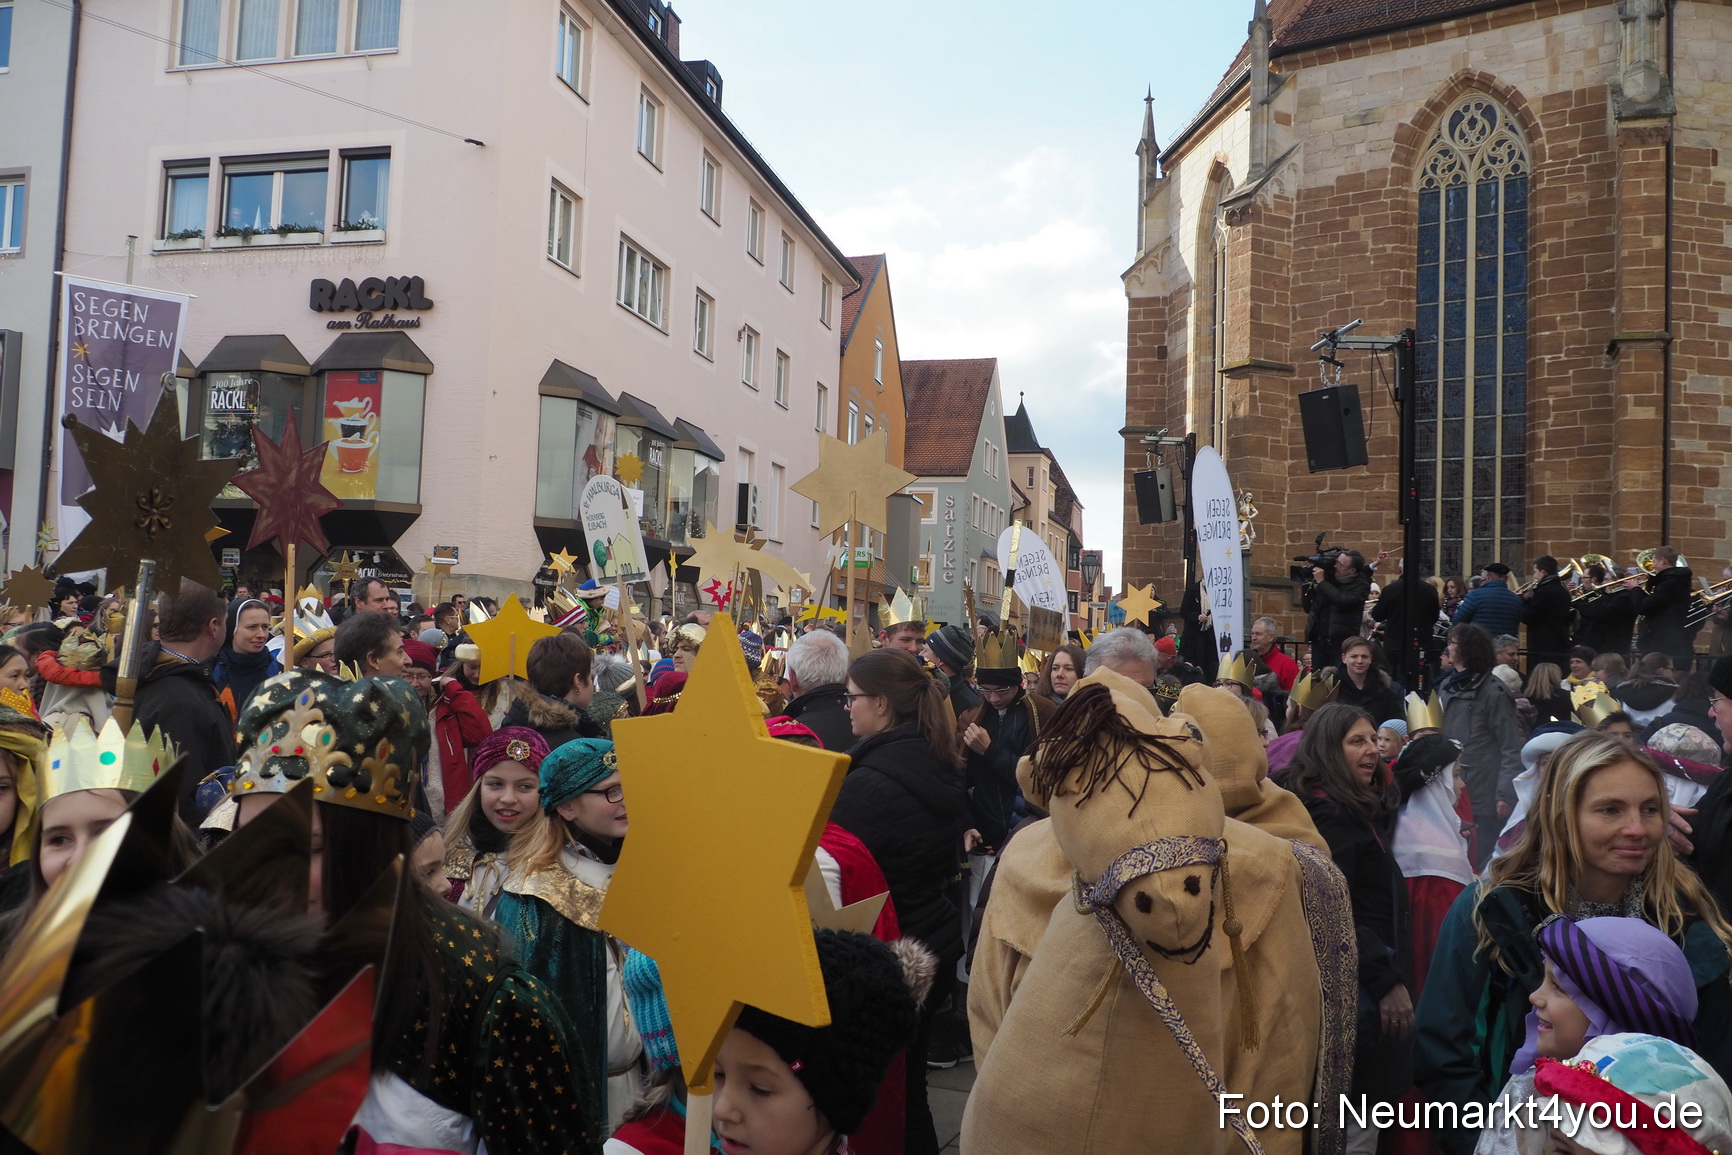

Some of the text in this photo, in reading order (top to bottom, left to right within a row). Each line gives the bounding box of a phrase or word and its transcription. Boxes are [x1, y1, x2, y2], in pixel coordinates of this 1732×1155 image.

[74, 292, 149, 323] SEGEN
[310, 275, 434, 312] RACKL
[74, 316, 173, 348] BRINGEN
[326, 311, 421, 329] am Rathaus
[72, 364, 140, 392] SEGEN
[229, 377, 253, 388] Jahre
[71, 387, 122, 411] SEIN
[943, 495, 956, 584] satzke
